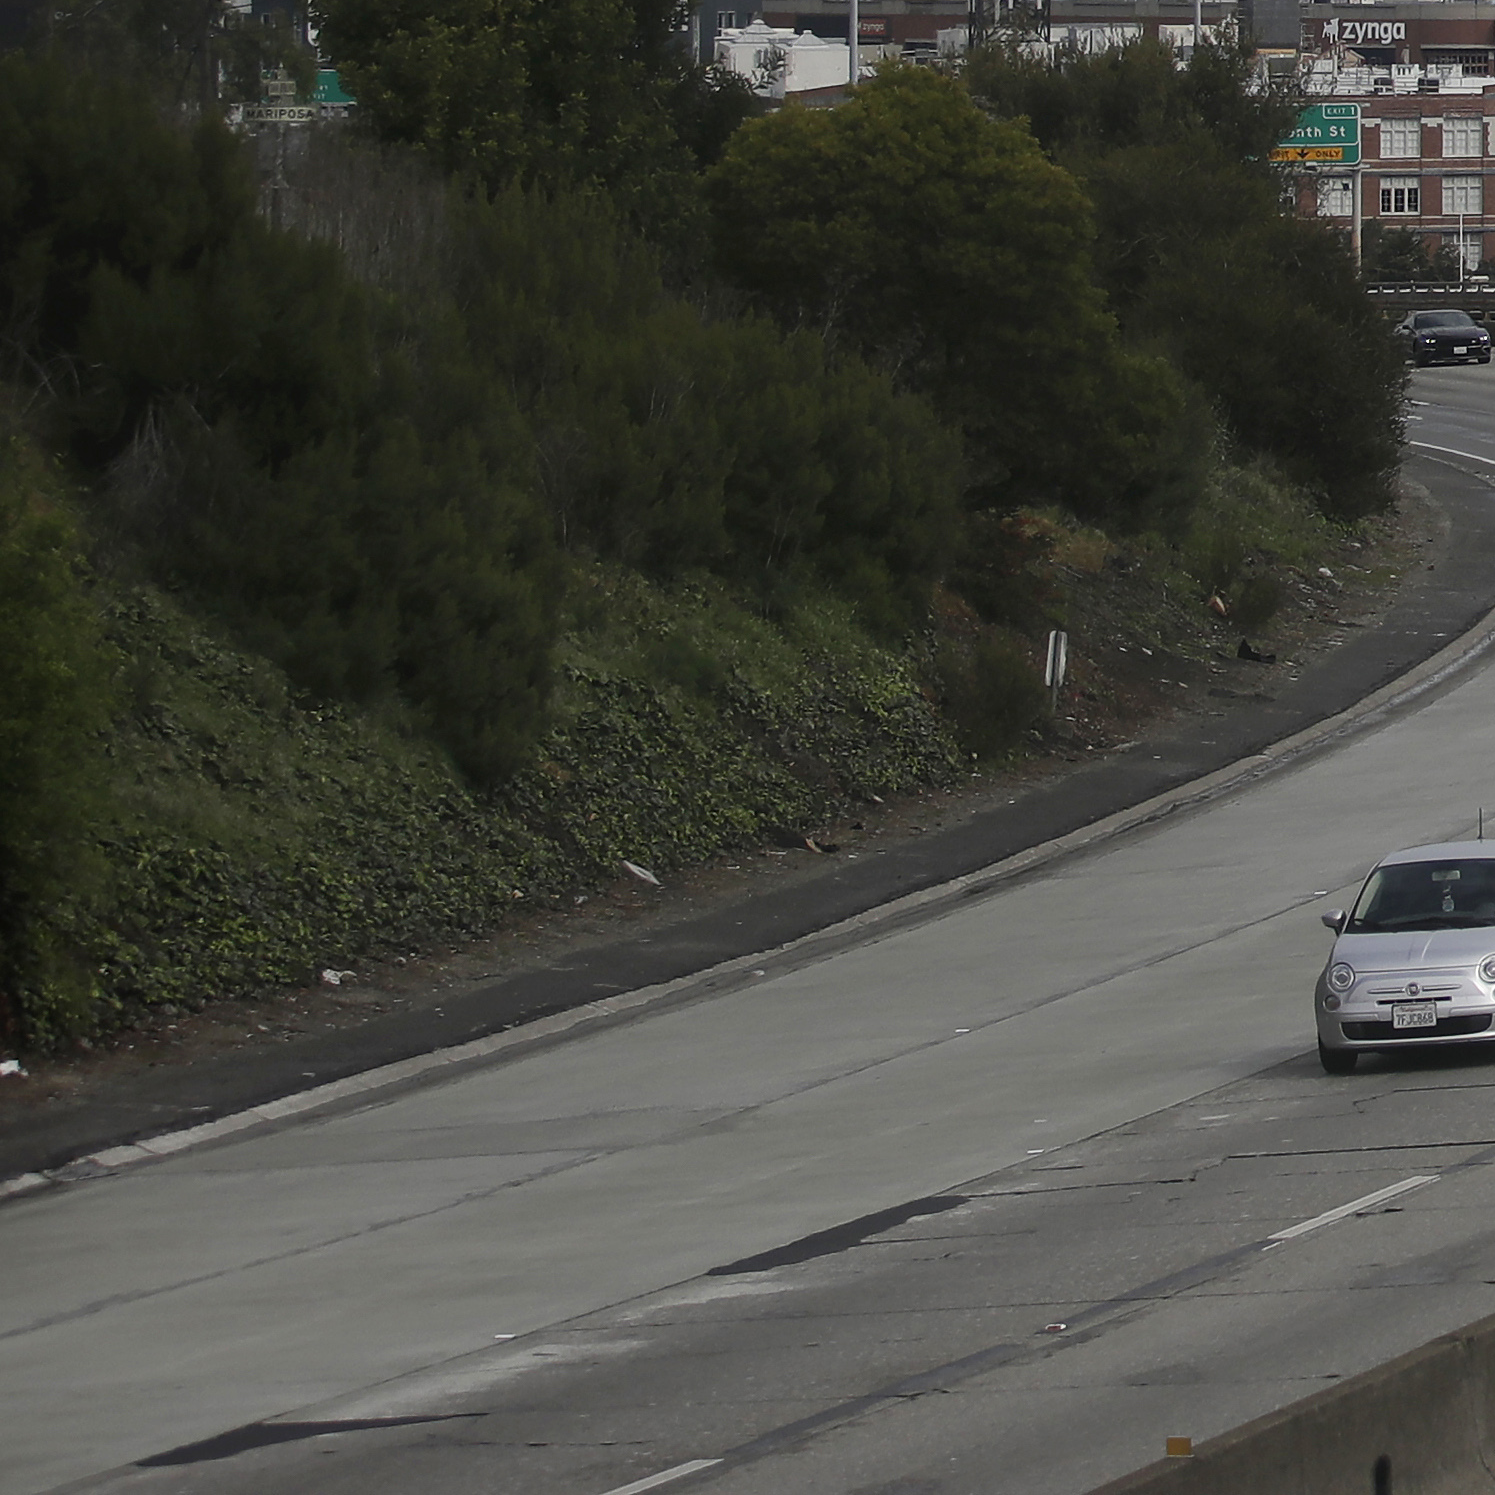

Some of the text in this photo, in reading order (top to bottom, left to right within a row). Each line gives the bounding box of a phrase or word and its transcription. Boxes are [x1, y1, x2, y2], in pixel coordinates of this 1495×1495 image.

[1342, 22, 1406, 44] zynga
[246, 108, 314, 119] MARIPOSA
[1350, 107, 1355, 115] 1
[1329, 126, 1346, 137] St
[1315, 150, 1340, 158] ONLY
